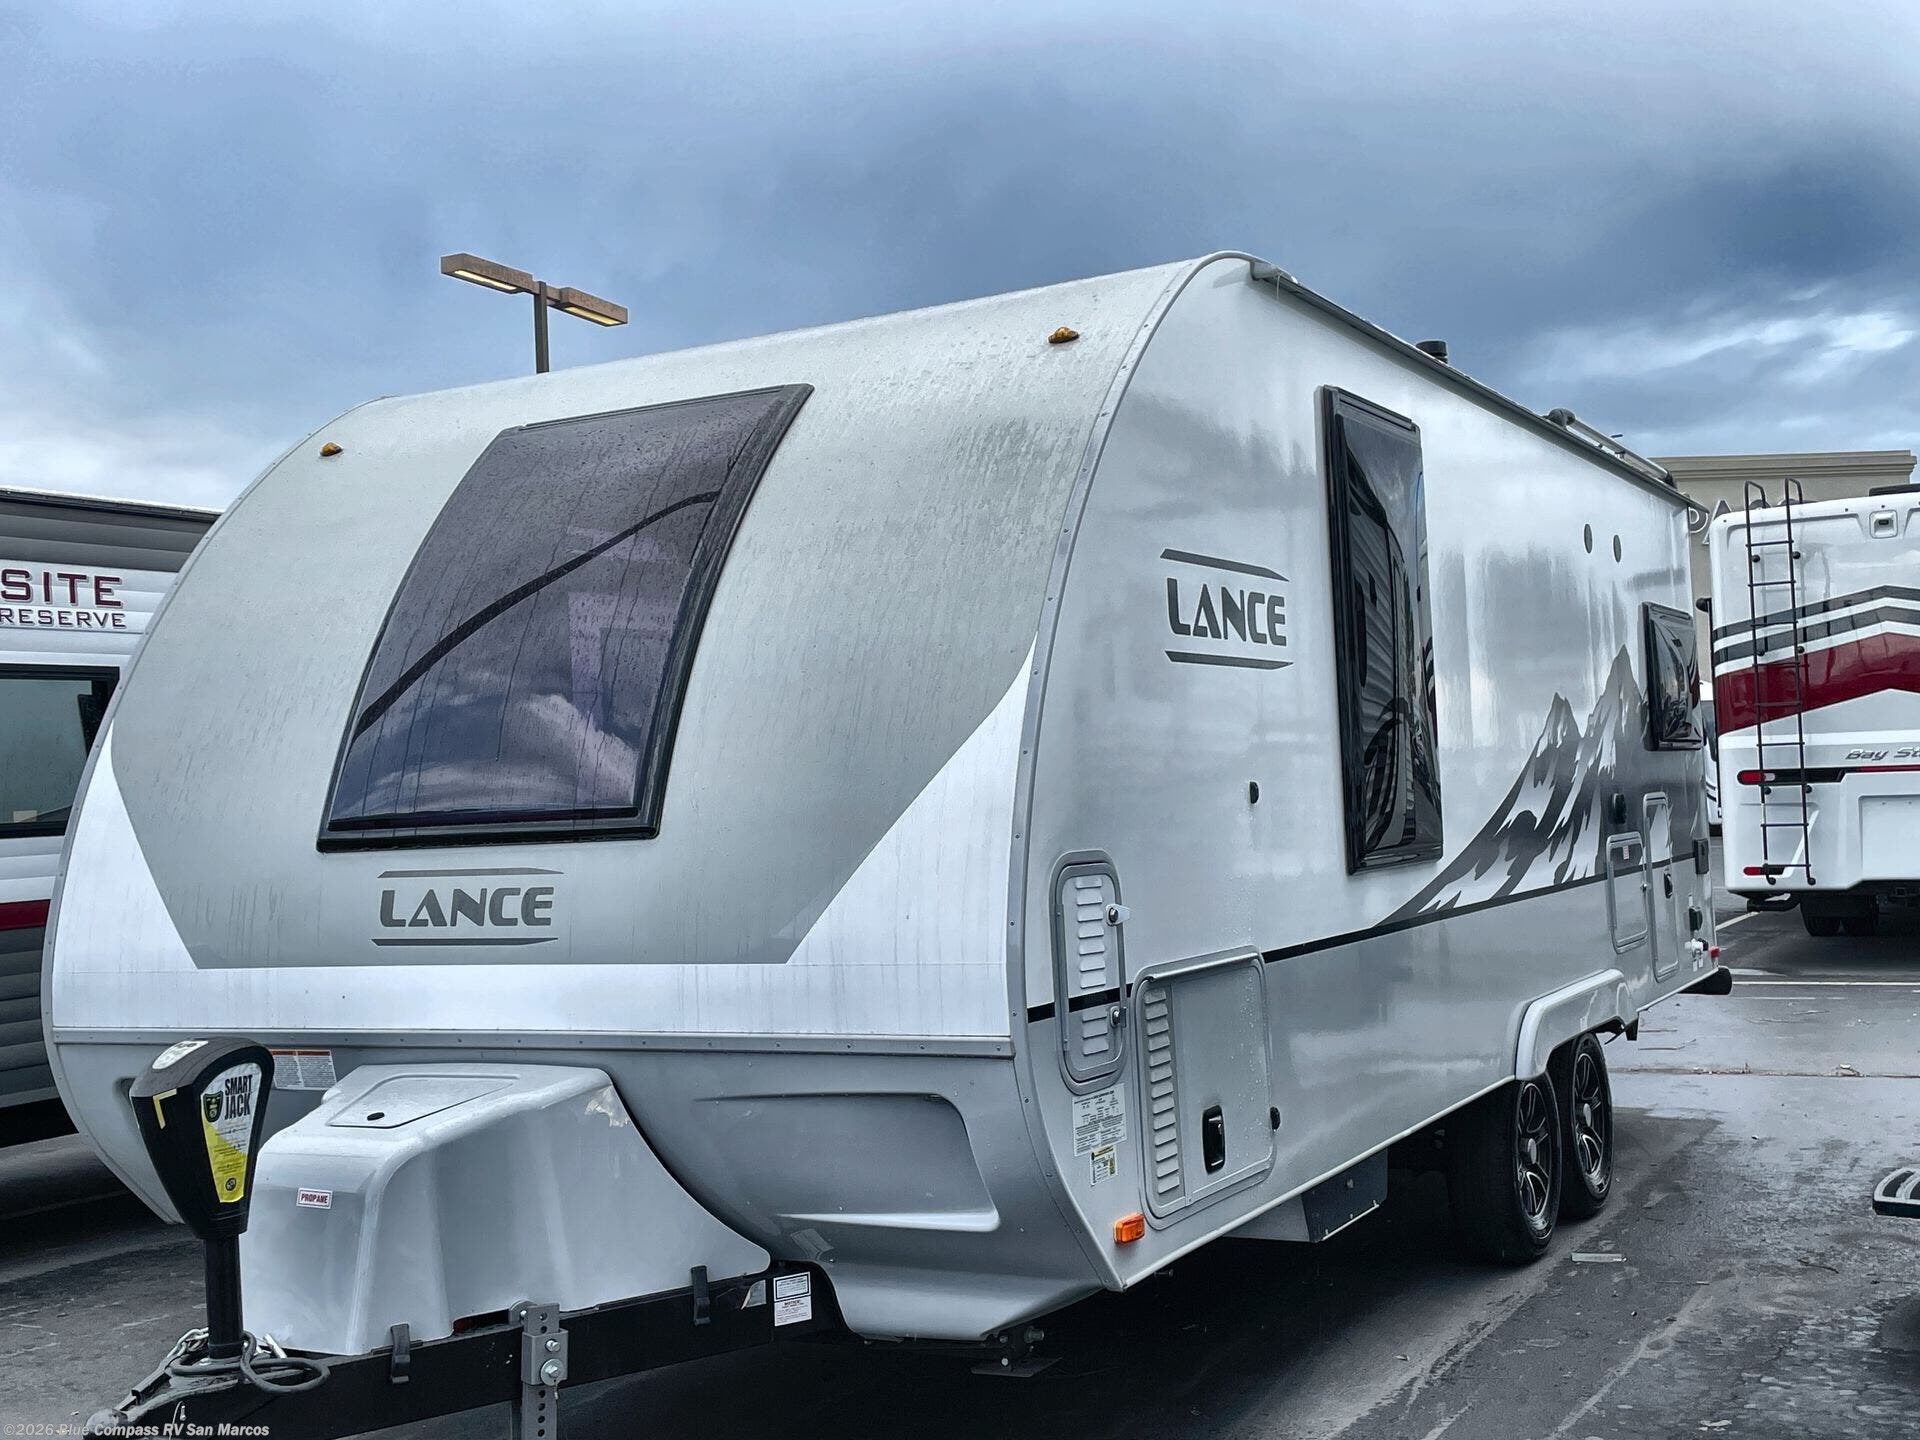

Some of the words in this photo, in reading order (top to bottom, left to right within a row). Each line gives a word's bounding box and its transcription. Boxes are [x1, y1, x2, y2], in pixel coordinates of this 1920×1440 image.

[0, 568, 122, 607] SITE
[0, 608, 126, 628] RESERVE
[1167, 577, 1287, 647] LANCE
[1845, 748, 1889, 761] Bay
[1893, 746, 1920, 758] St
[380, 887, 554, 927] LANCE
[225, 1074, 253, 1096] SMART
[225, 1093, 251, 1120] JACK
[301, 1193, 329, 1204] PROPANE
